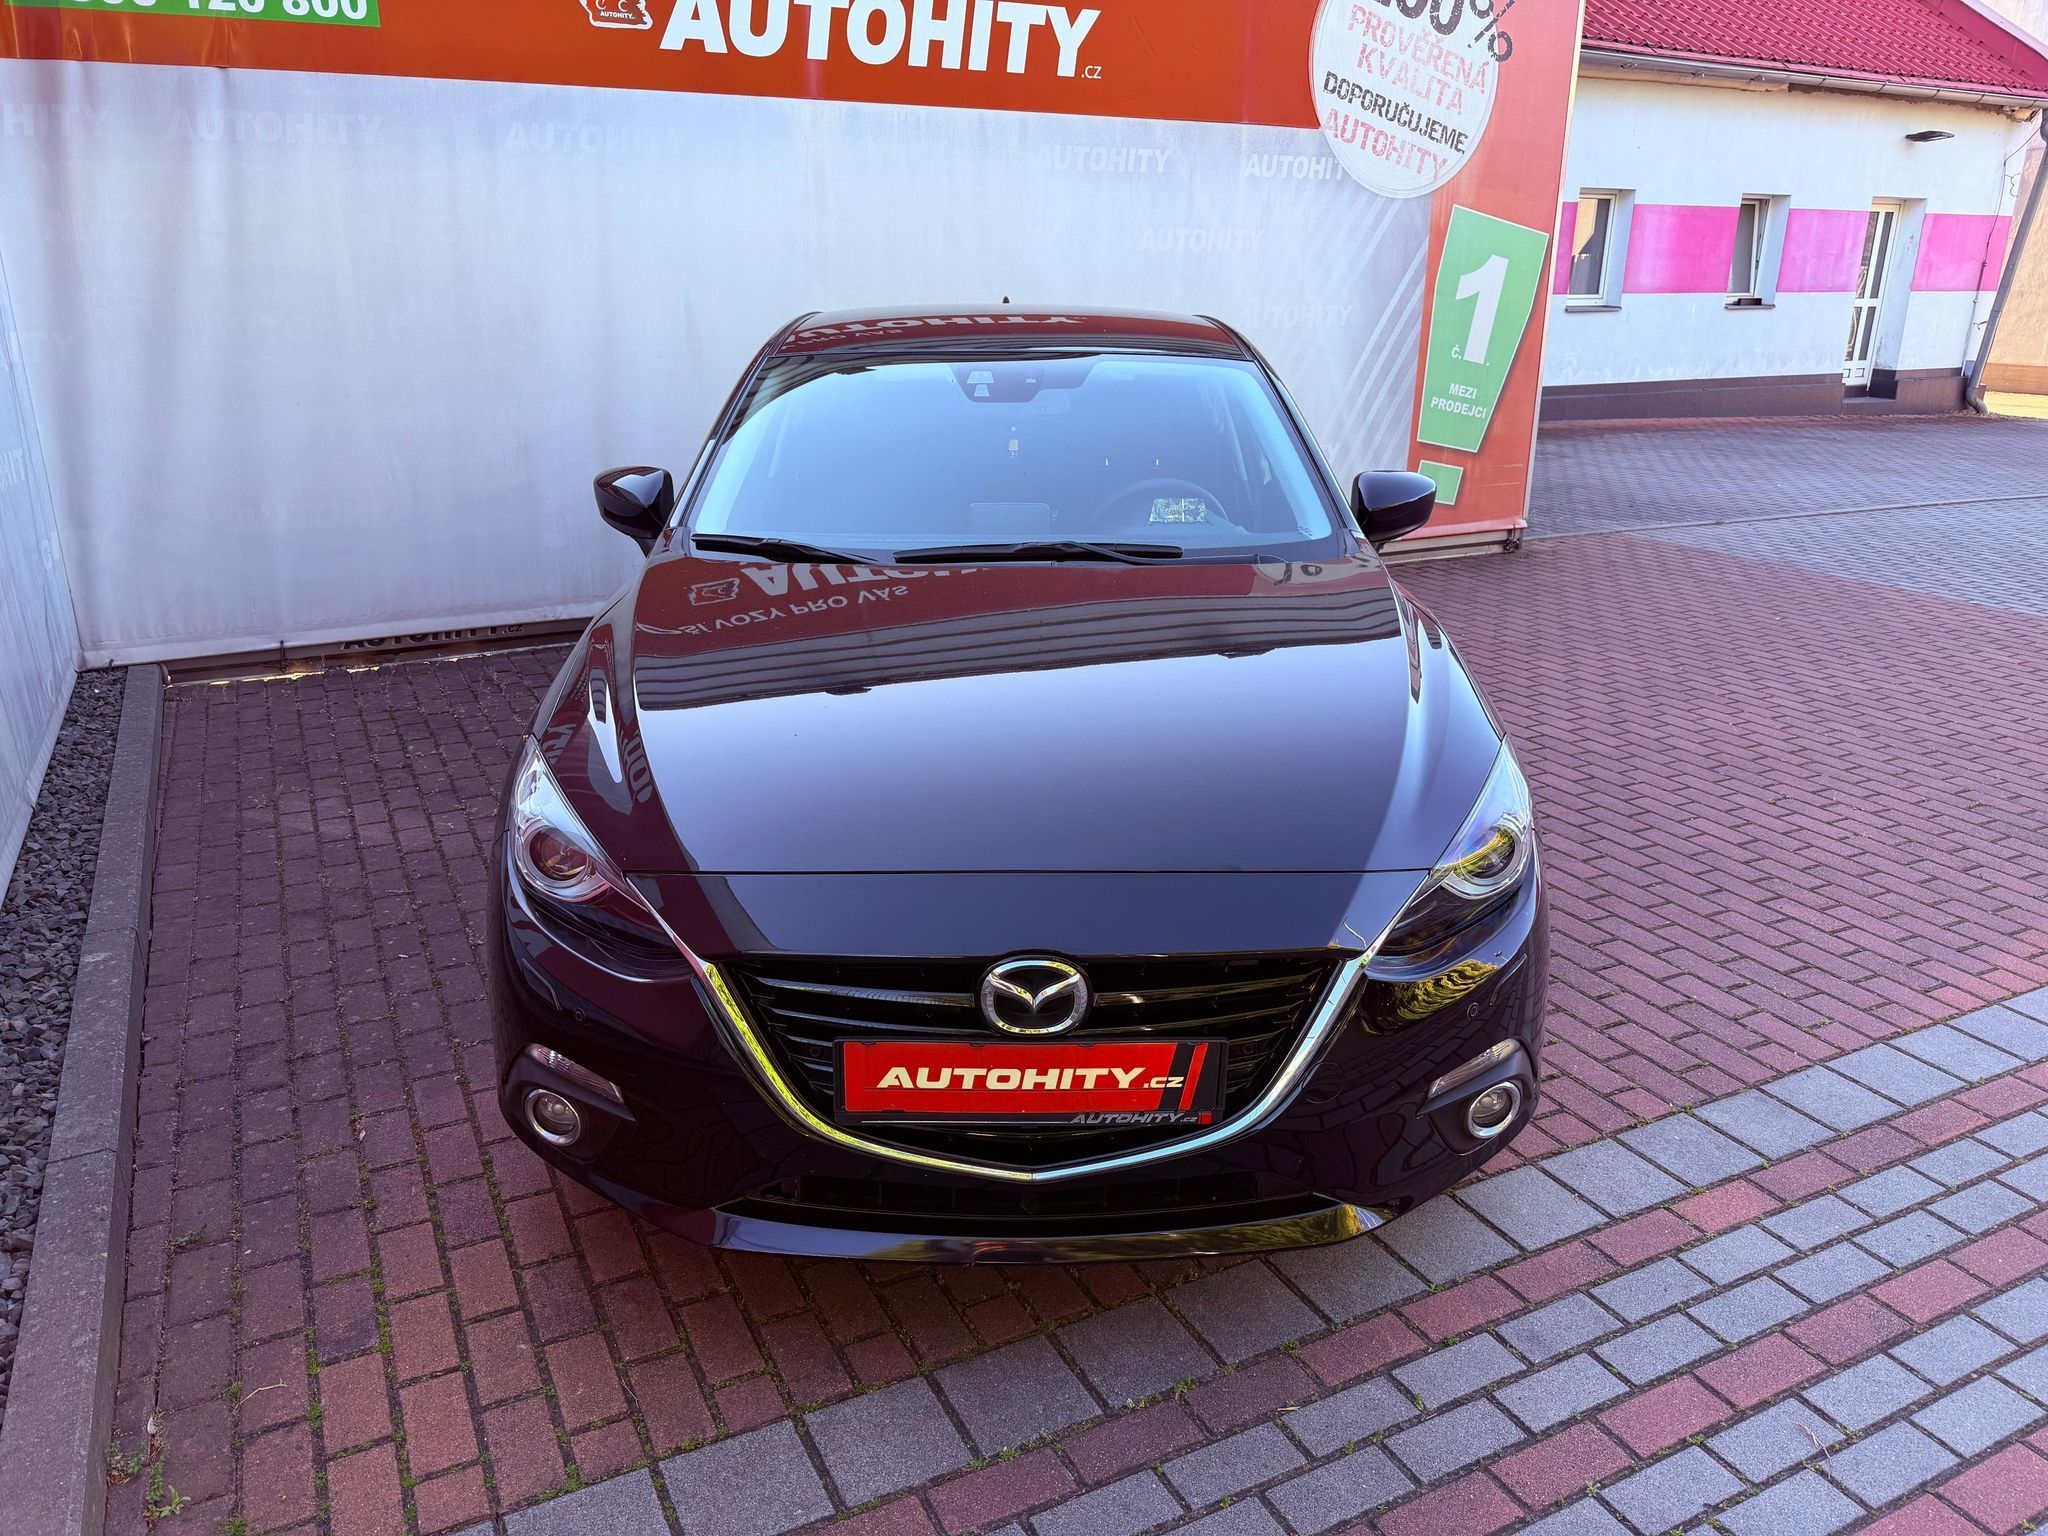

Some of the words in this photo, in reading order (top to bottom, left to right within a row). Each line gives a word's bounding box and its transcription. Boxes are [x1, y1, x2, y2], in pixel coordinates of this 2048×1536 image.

[1347, 4, 1490, 95] PROVĚŘENÁ
[1356, 42, 1465, 116] KVALITA
[1322, 70, 1469, 155] DOPORUČUJEME
[1035, 144, 1170, 175] AUTOHITY
[1243, 152, 1354, 181] AUTOHIT
[1324, 108, 1448, 182] AUTOHITY
[1430, 396, 1488, 420] PRODEJCI
[1448, 382, 1477, 400] MEZI
